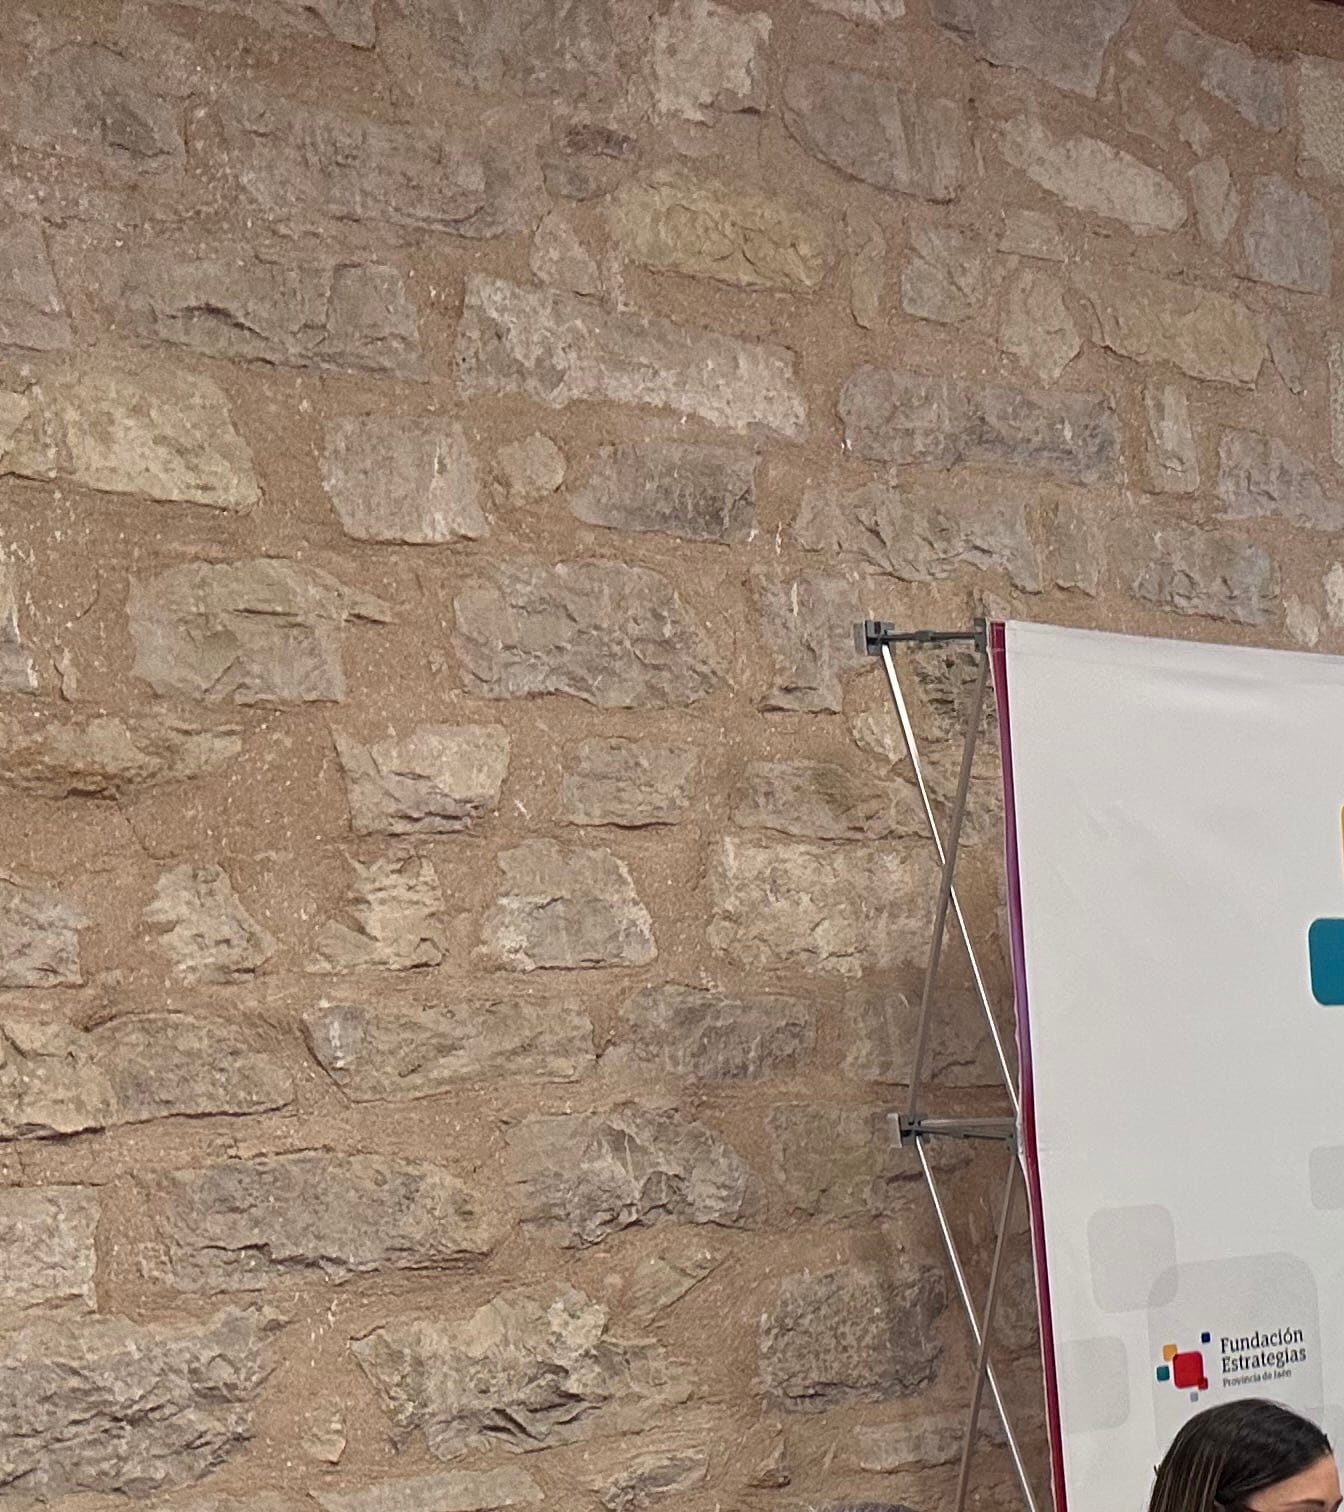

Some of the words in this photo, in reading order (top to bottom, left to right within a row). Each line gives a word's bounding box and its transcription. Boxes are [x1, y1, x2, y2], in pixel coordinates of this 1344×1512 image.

[1220, 1326, 1304, 1354] Fundación
[1222, 1347, 1307, 1374] Estrategias
[1223, 1373, 1261, 1388] Provincia
[1262, 1369, 1273, 1380] de
